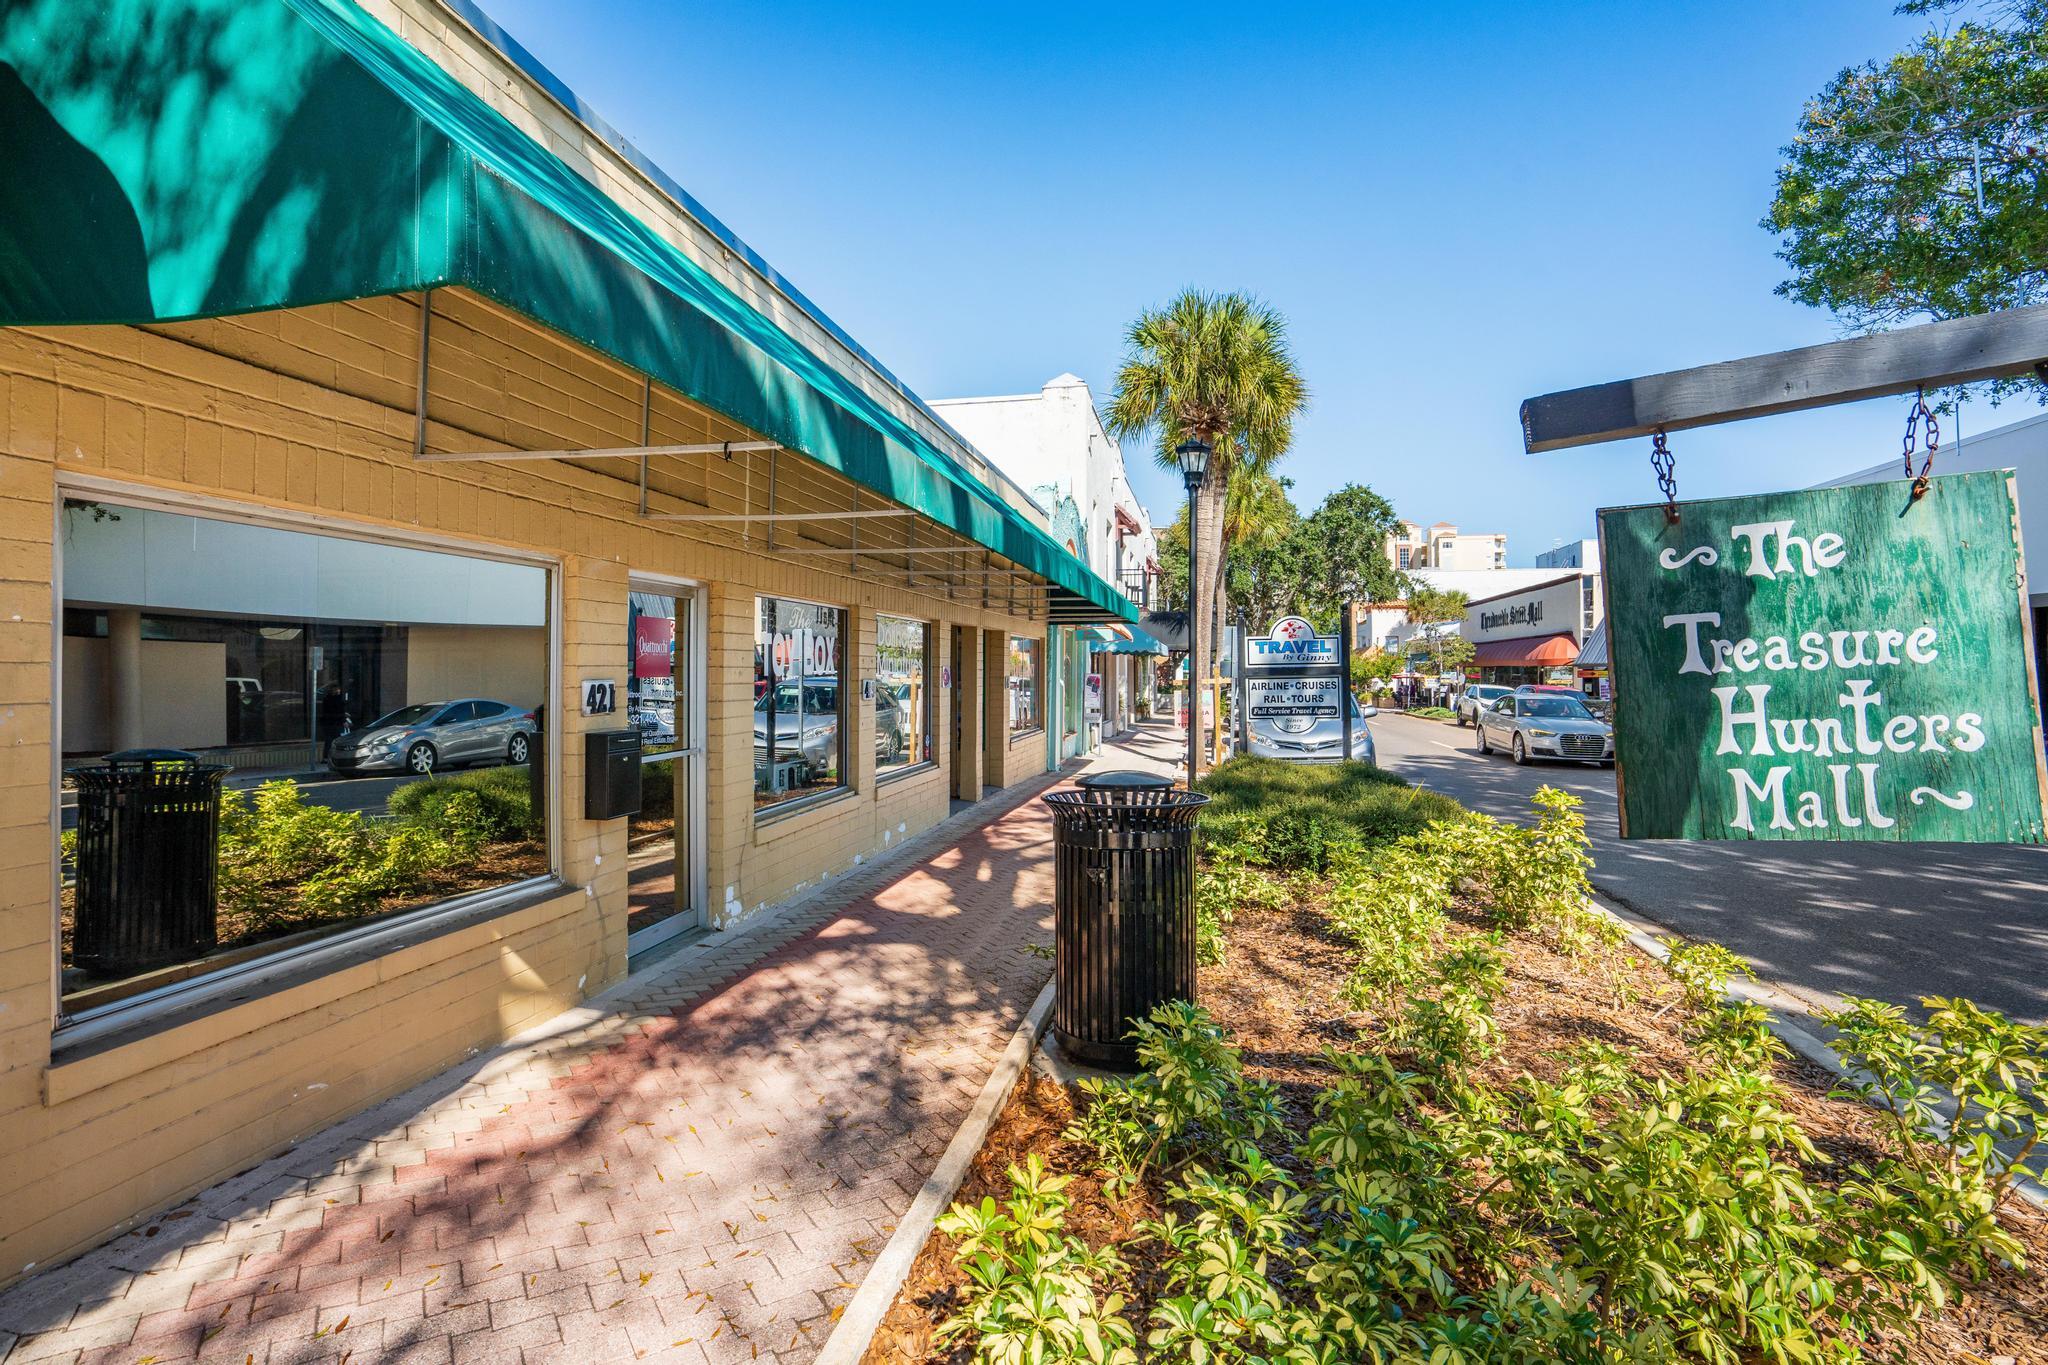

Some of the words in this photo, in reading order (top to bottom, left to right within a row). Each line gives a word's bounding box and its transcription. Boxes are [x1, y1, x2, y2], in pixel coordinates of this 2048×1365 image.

[1731, 519, 1846, 580] The
[789, 606, 812, 629] The
[1527, 600, 1543, 627] Mall
[803, 630, 836, 676] BOX
[1255, 640, 1332, 654] TRAVEL
[1662, 611, 1939, 676] Treasure
[1297, 654, 1332, 663] Ginny
[587, 684, 616, 714] 421
[1251, 682, 1289, 691] AIRLINE
[1295, 681, 1337, 690] CRUISES
[1263, 695, 1286, 703] RAIL
[1291, 695, 1324, 703] TOURS
[1313, 707, 1336, 715] Agency
[1710, 679, 1986, 757] Hunters
[1727, 763, 1895, 832] Mall
